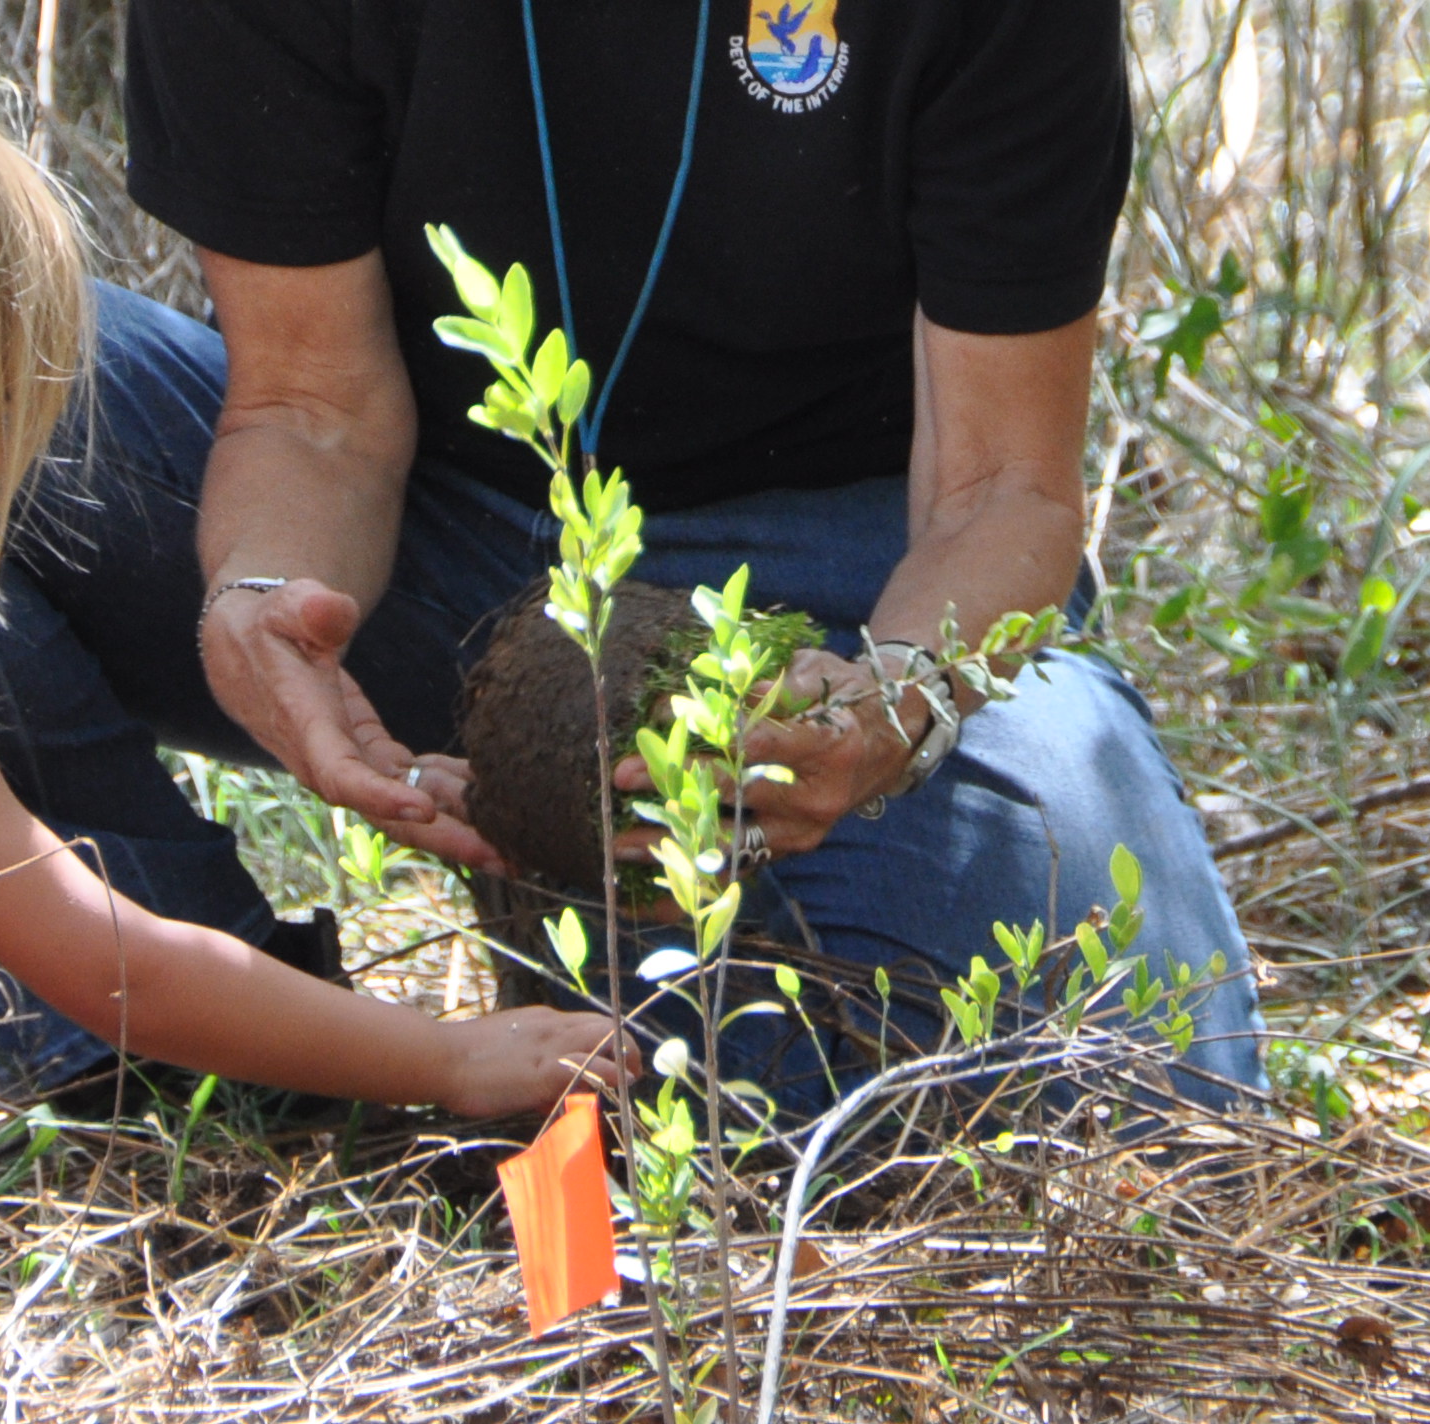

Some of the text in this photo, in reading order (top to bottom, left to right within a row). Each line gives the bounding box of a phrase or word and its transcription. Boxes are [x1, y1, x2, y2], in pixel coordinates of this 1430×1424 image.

[748, 80, 771, 100] OF
[772, 94, 805, 113] THE
[804, 40, 850, 111] INTERIOR
